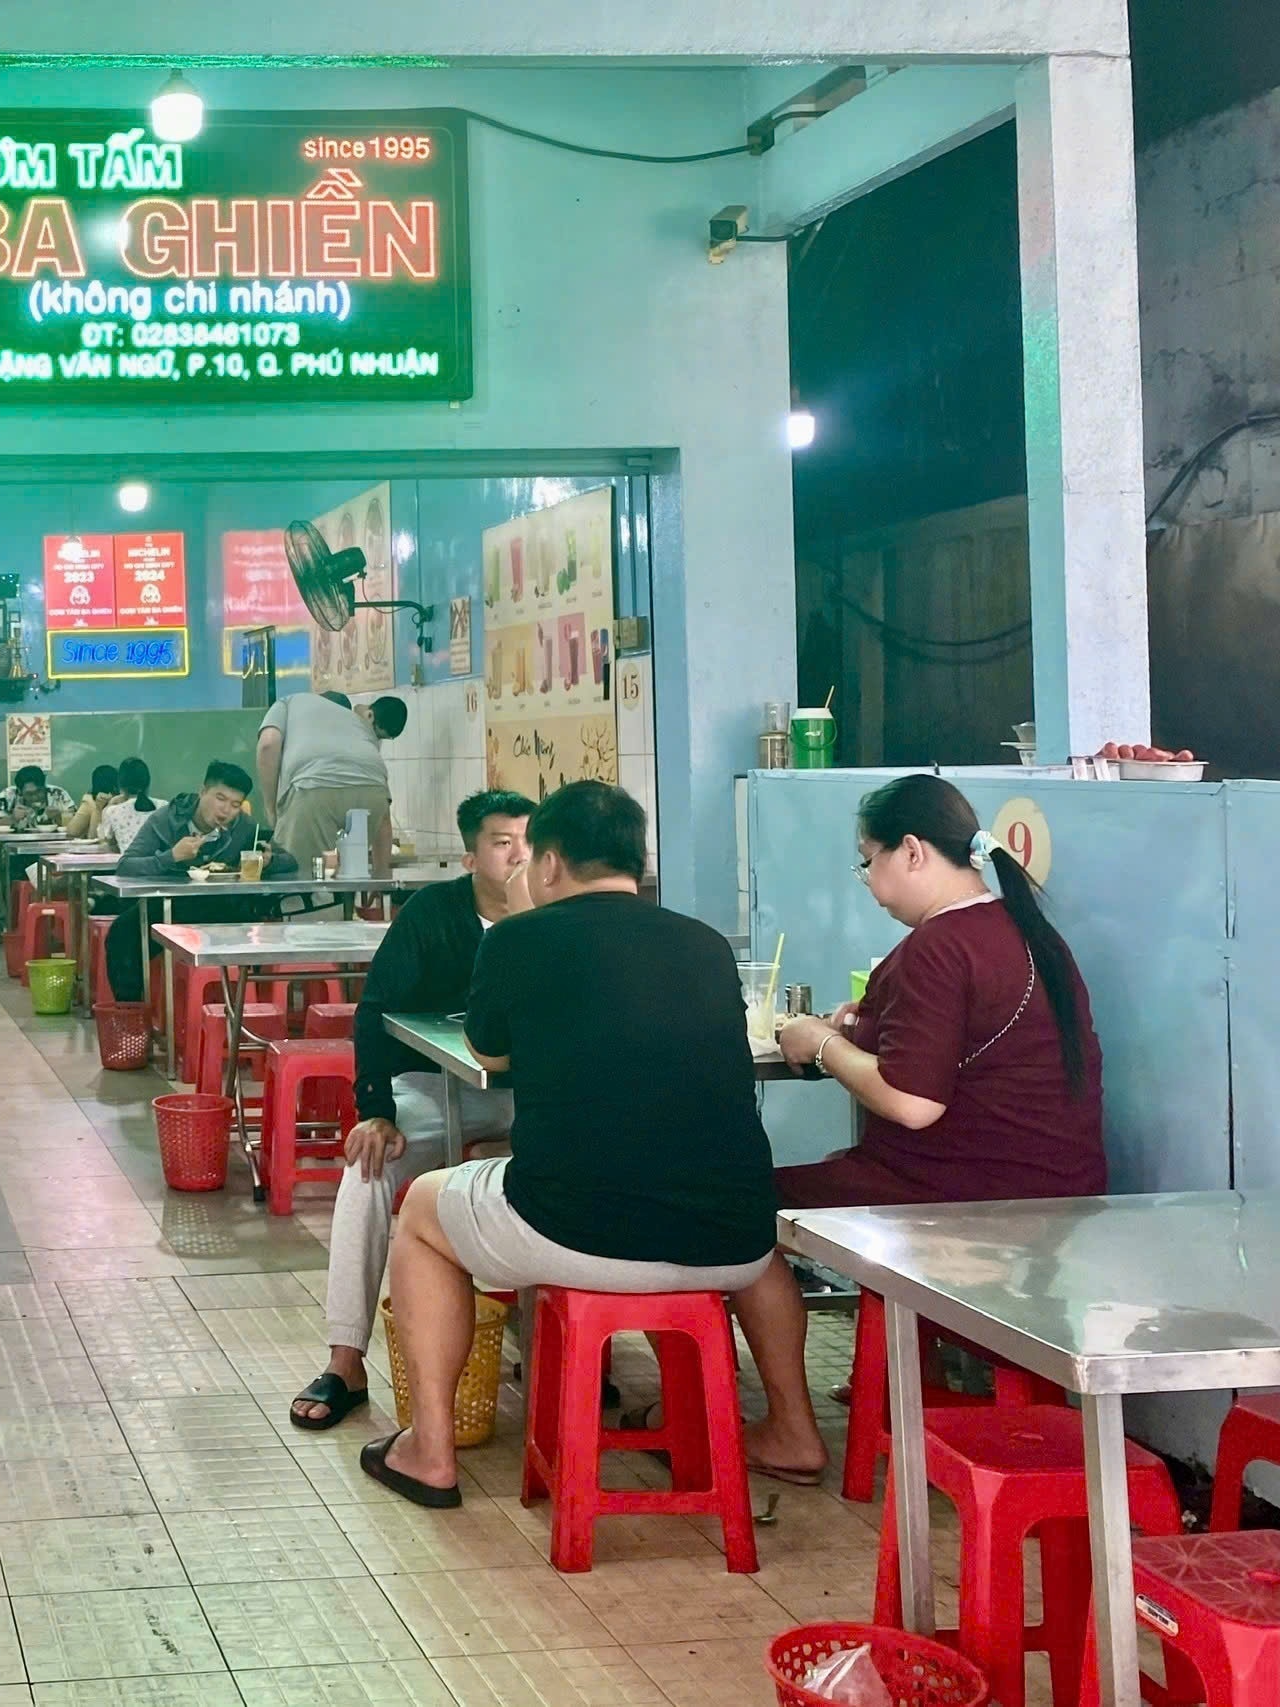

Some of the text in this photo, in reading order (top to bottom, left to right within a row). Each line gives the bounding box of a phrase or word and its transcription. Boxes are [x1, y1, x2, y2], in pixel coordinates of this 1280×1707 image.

[69, 128, 183, 188] TẤM
[120, 168, 435, 278] GHIỀN
[29, 280, 351, 322] (không chi nhánh)
[58, 349, 112, 380] VĂN
[290, 347, 344, 378] PHÚ
[349, 347, 440, 379] NHUẬN
[62, 638, 176, 667] Since 1995
[466, 692, 478, 713] 16
[622, 674, 639, 700] 15
[1007, 821, 1032, 869] 9
